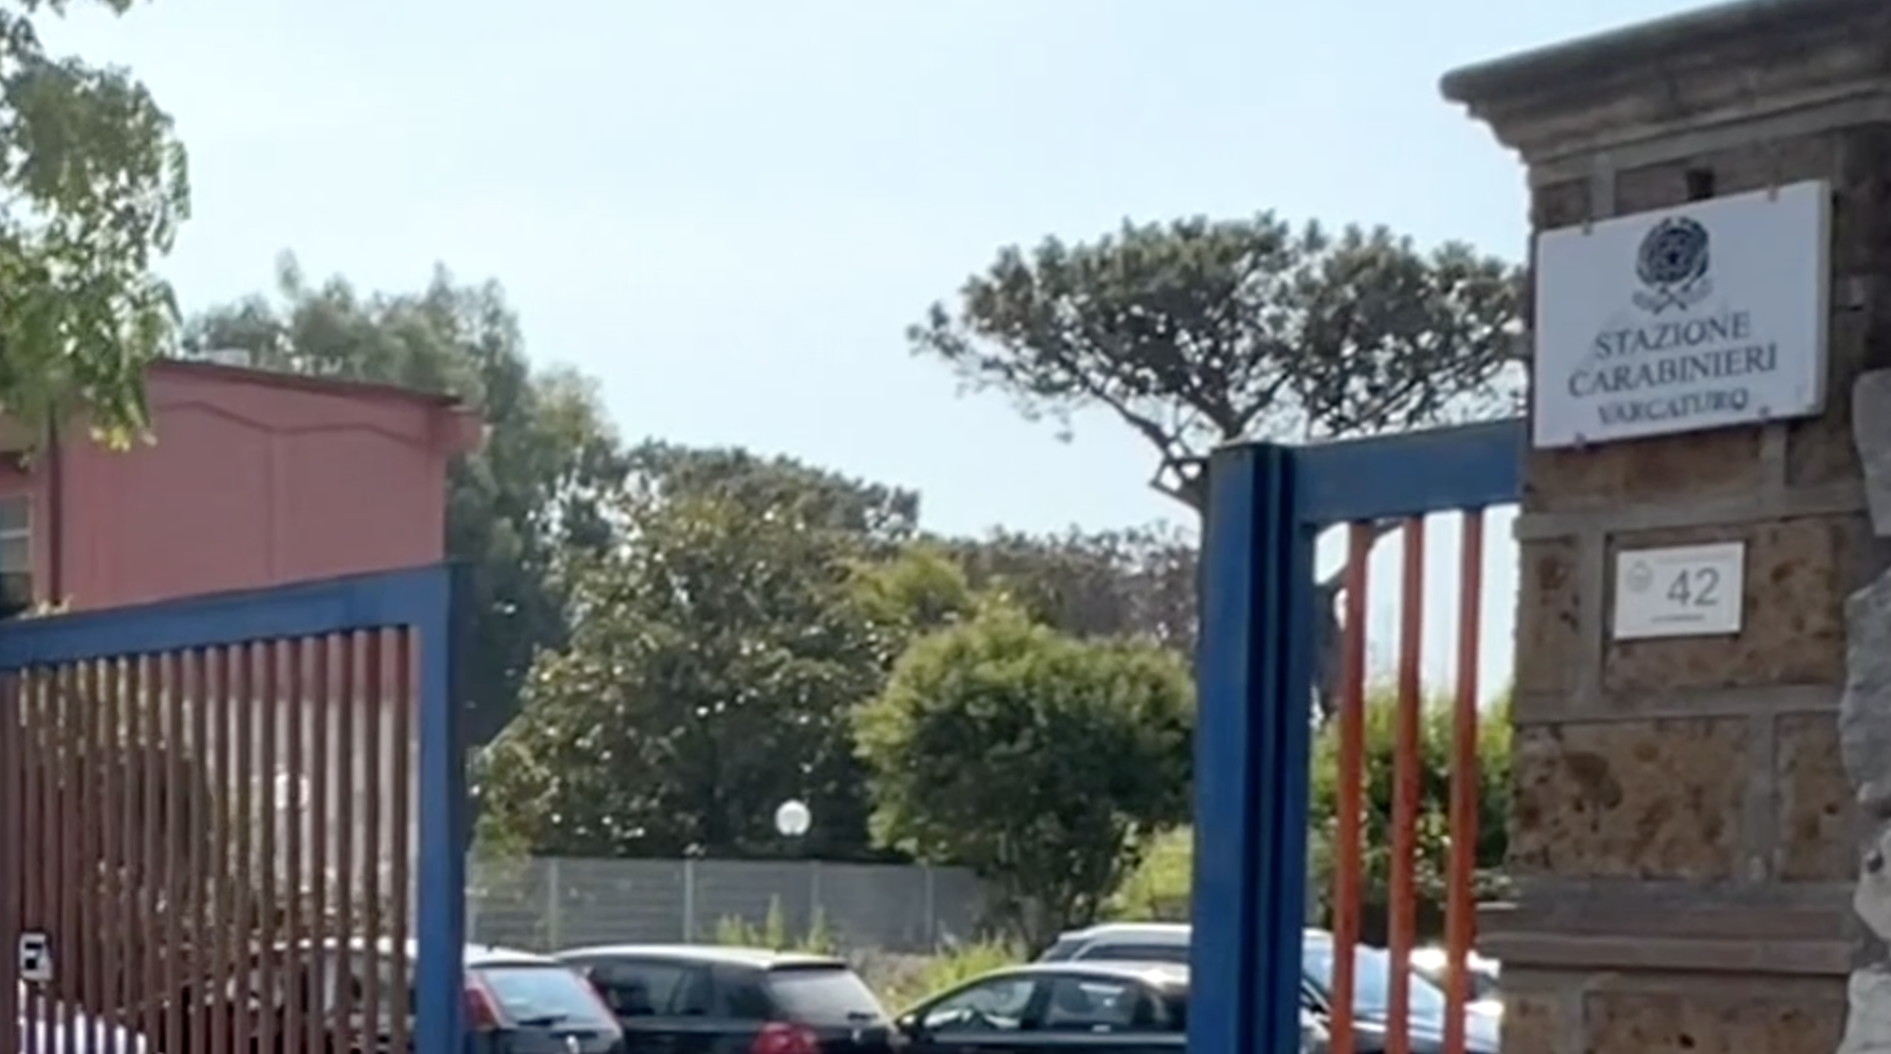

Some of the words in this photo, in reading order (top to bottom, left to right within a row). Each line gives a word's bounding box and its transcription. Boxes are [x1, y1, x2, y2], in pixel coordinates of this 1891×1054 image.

[1595, 311, 1751, 360] STAZIONE
[1567, 342, 1778, 398] CARABINIERI
[1666, 566, 1721, 606] 42
